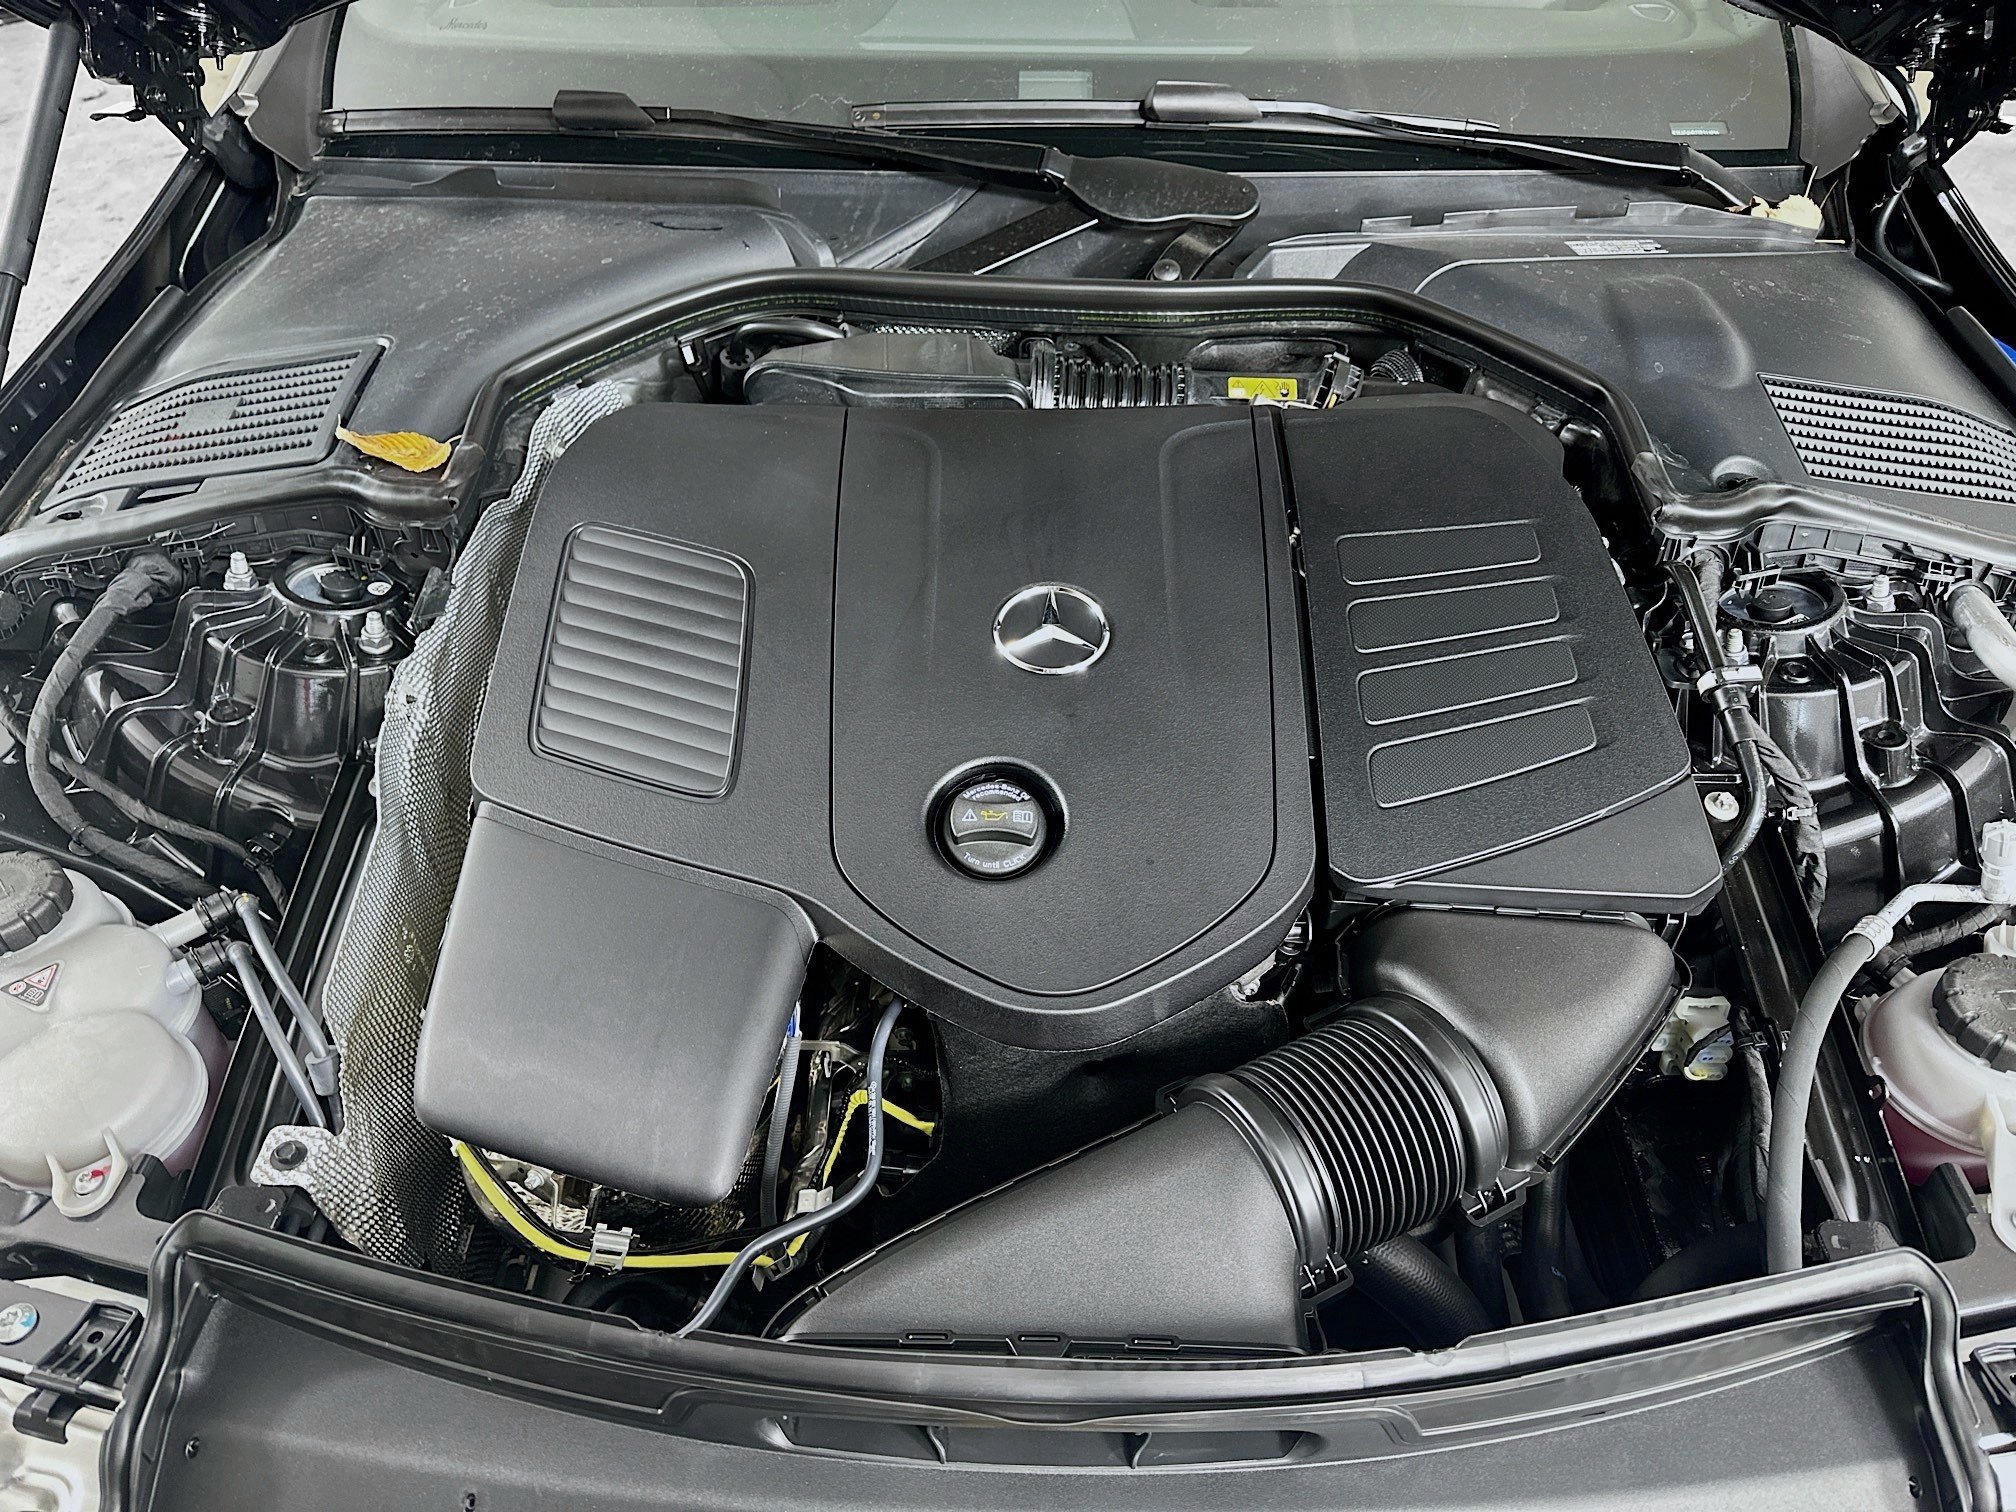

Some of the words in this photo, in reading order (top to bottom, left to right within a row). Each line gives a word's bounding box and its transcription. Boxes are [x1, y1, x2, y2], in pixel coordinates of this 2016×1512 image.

[962, 784, 1020, 799] Mercedes-Benz
[972, 789, 1021, 802] recommended
[964, 852, 980, 866] Turn
[982, 861, 1000, 869] until
[1003, 853, 1027, 868] CLICK
